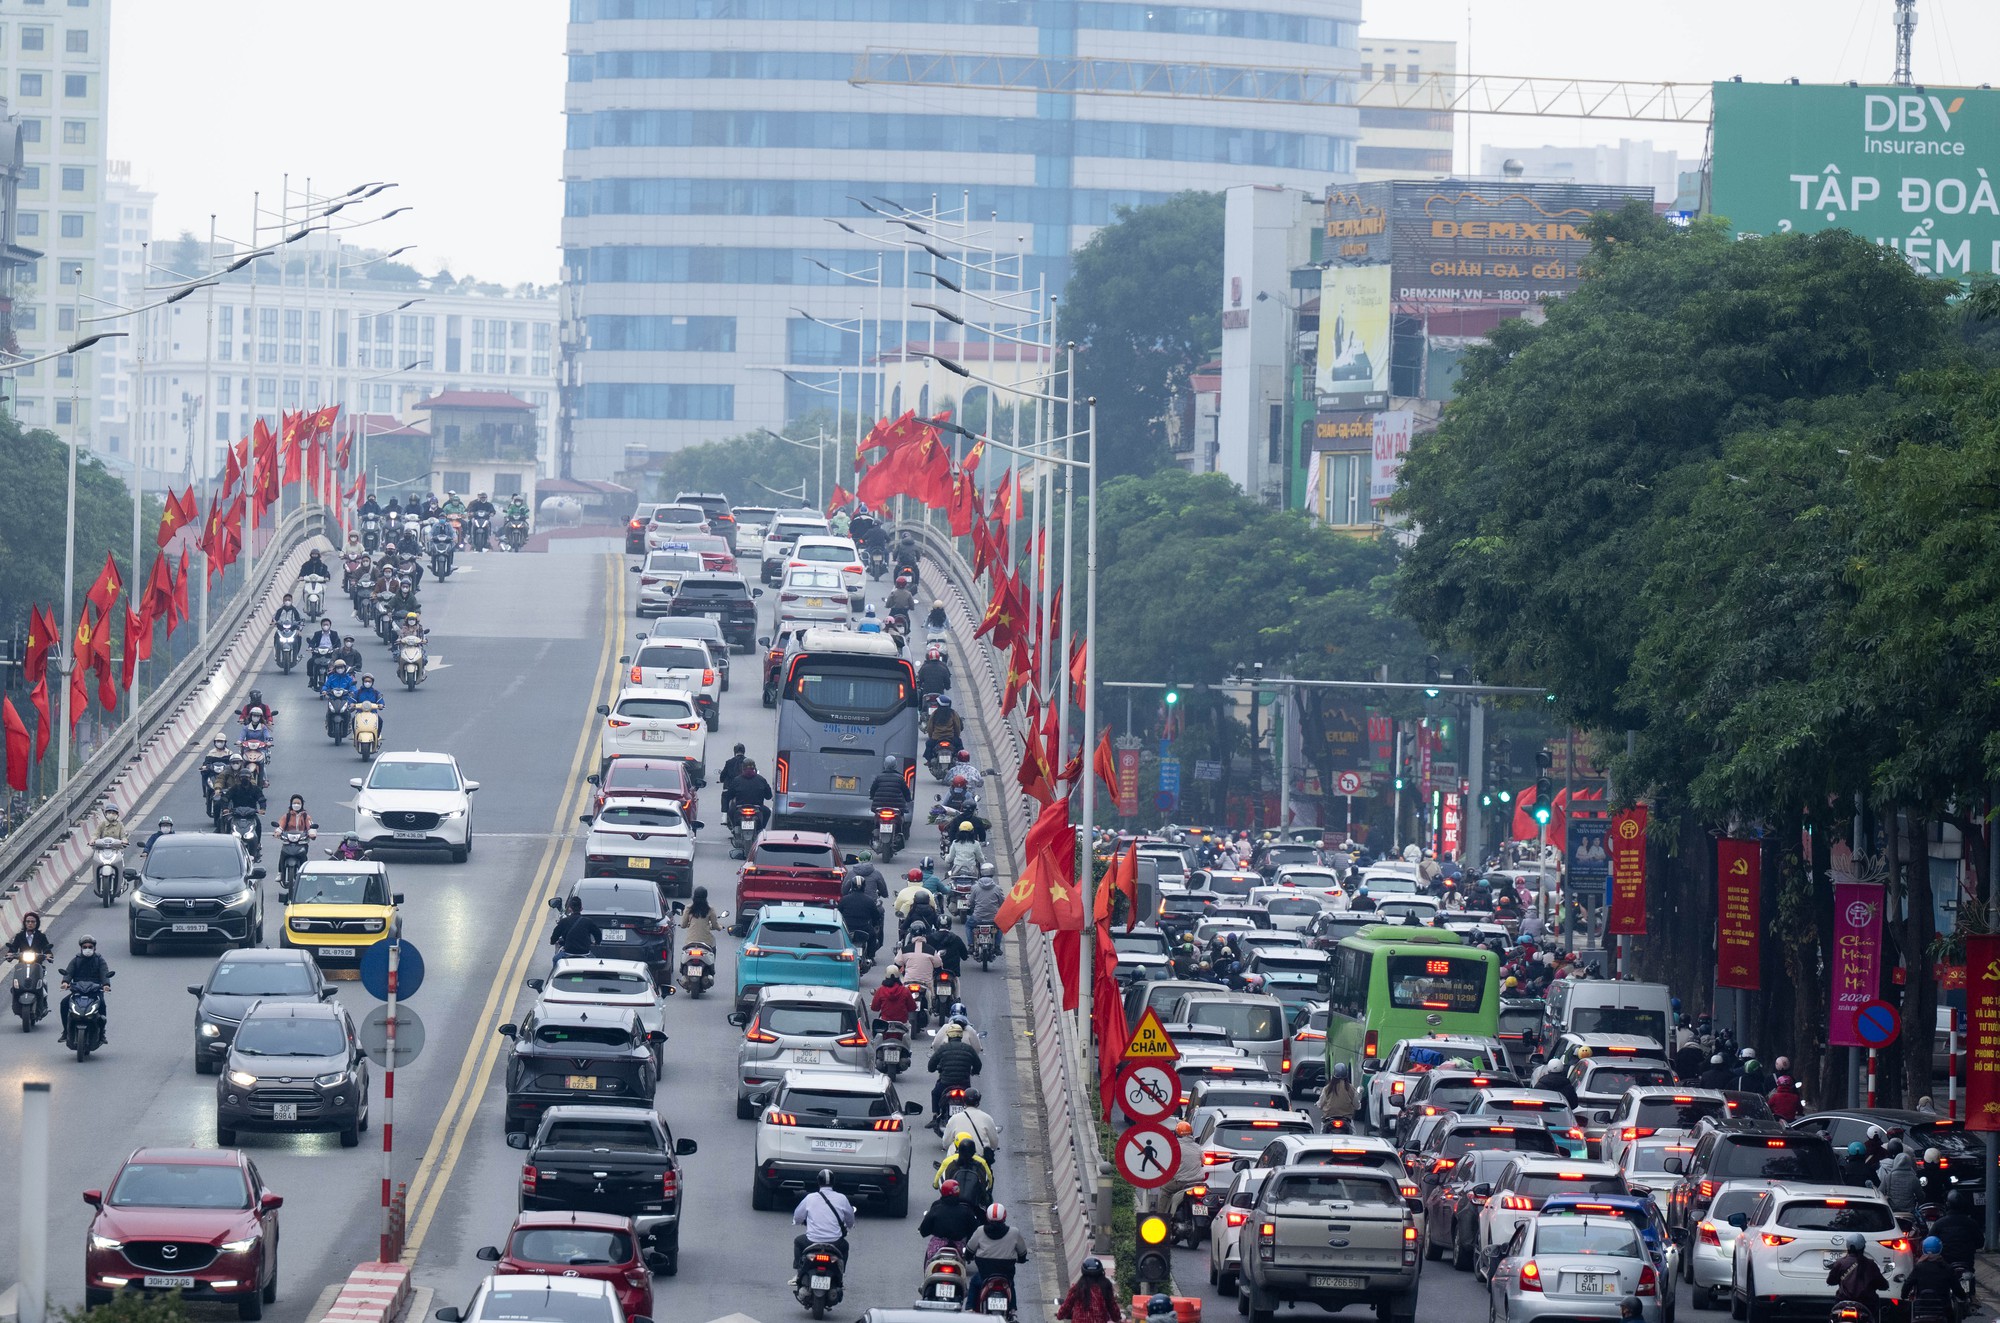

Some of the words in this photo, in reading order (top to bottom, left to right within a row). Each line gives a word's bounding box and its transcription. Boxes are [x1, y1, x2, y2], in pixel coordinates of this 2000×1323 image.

[1865, 95, 1964, 132] DBV
[1864, 136, 1965, 155] Insurance
[1790, 164, 1880, 221] TẬP
[1898, 168, 2000, 215] ĐOÀ
[1432, 221, 1592, 241] DEMXIN
[1488, 245, 1557, 256] LUXURY
[1400, 287, 1482, 300] DEMXINH.VN
[1498, 289, 1530, 301] 1800
[831, 714, 870, 722] TRACOMECO
[1447, 793, 1458, 805] XE
[1446, 811, 1457, 824] GA
[1445, 830, 1457, 842] XE
[1841, 948, 1873, 969] Mừng
[1427, 961, 1449, 972] 105
[1843, 963, 1869, 976] Năm
[1435, 993, 1454, 1001] 1900
[1839, 993, 1871, 1002] 2026
[1981, 996, 1994, 1007] HỌC
[1975, 1009, 1983, 1018] VÀ
[1984, 1009, 1997, 1018] LÀM
[1979, 1022, 1987, 1031] TƯ
[1143, 1029, 1156, 1040] ĐI
[1980, 1036, 1992, 1046] ĐẠO
[1131, 1040, 1168, 1055] CHẬM
[1975, 1049, 1994, 1058] PHONG
[1974, 1060, 1983, 1071] HỒ
[1983, 1061, 1993, 1071] CHÍ
[815, 1140, 853, 1149] 30L-017.35
[1280, 1252, 1397, 1263] RANGER
[1316, 1276, 1358, 1287] 37C-266.59
[1583, 1274, 1597, 1283] 31F
[1581, 1283, 1598, 1292] 5411
